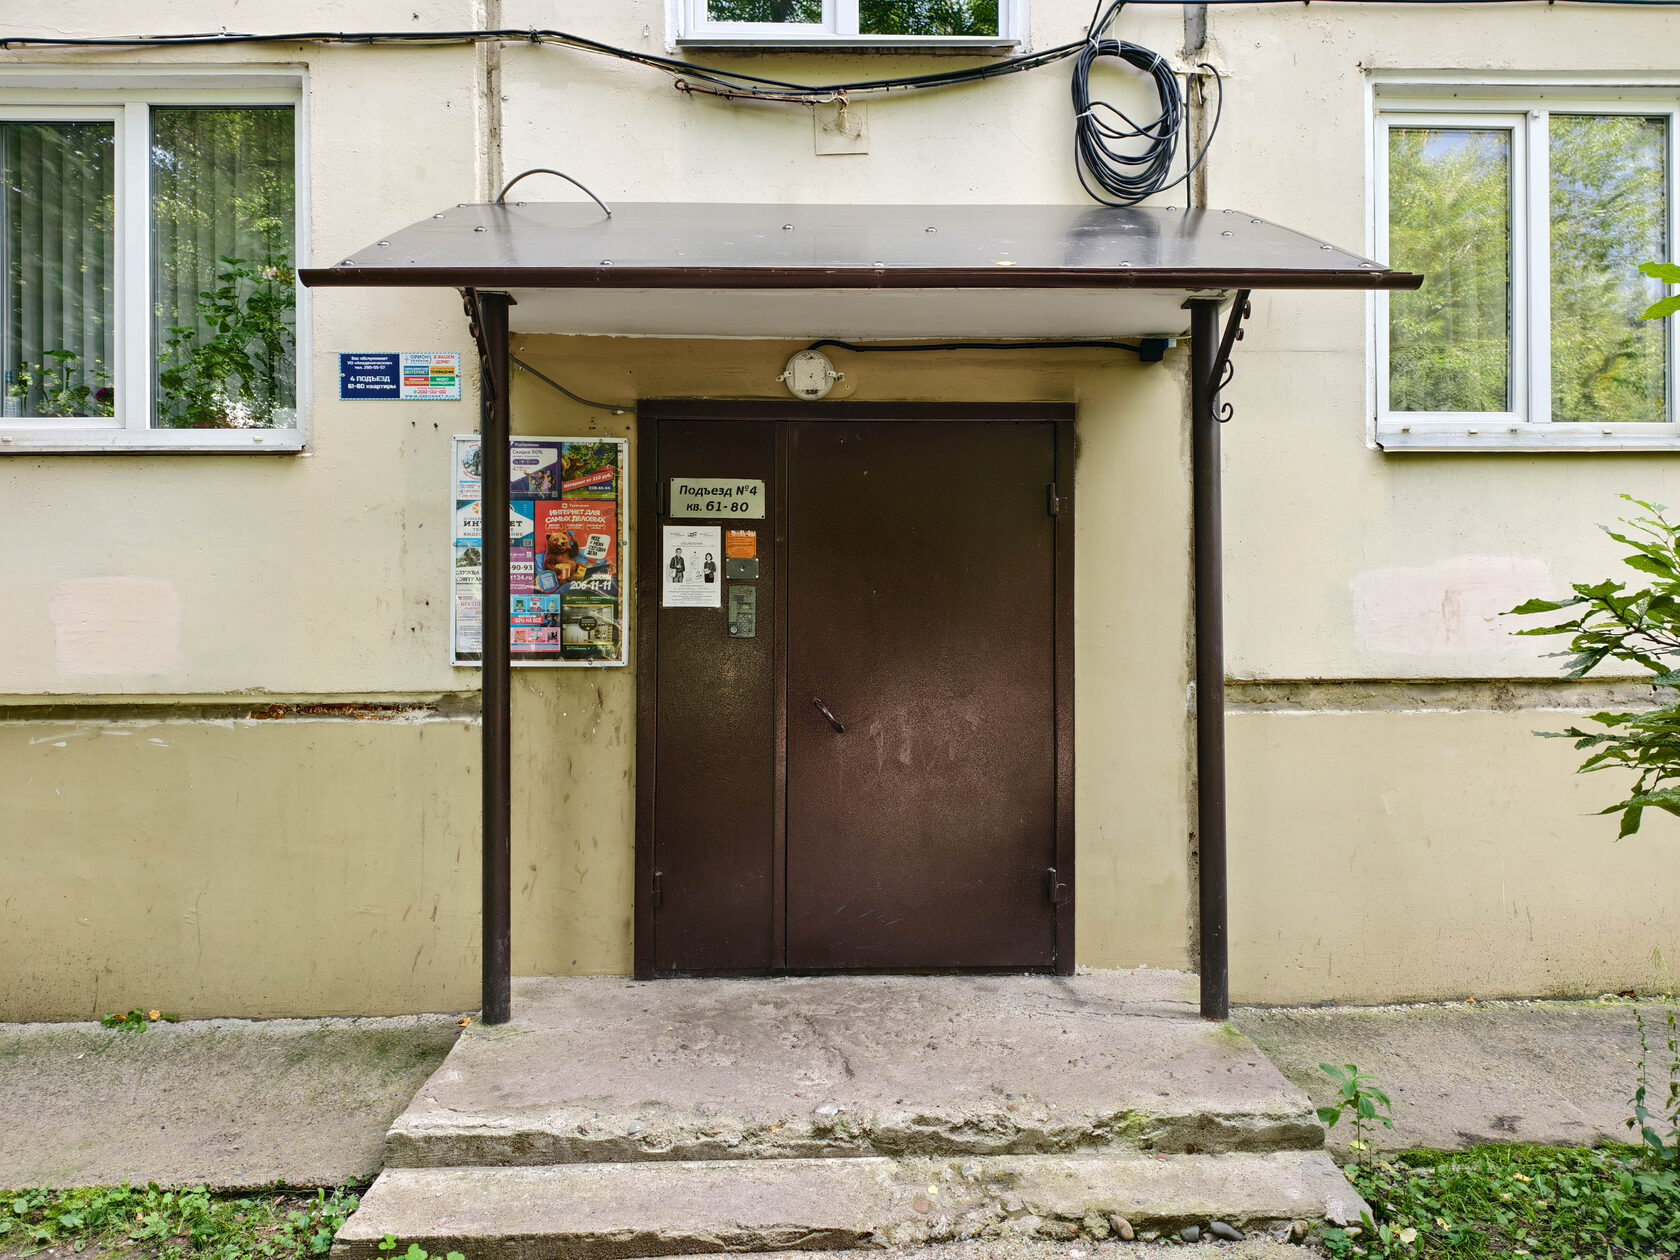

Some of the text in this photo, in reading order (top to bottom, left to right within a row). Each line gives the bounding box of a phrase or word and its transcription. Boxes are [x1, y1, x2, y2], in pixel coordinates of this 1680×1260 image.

[679, 485, 733, 497] Подъезд
[686, 503, 702, 512] кв.
[569, 580, 612, 590] 206-11-11
